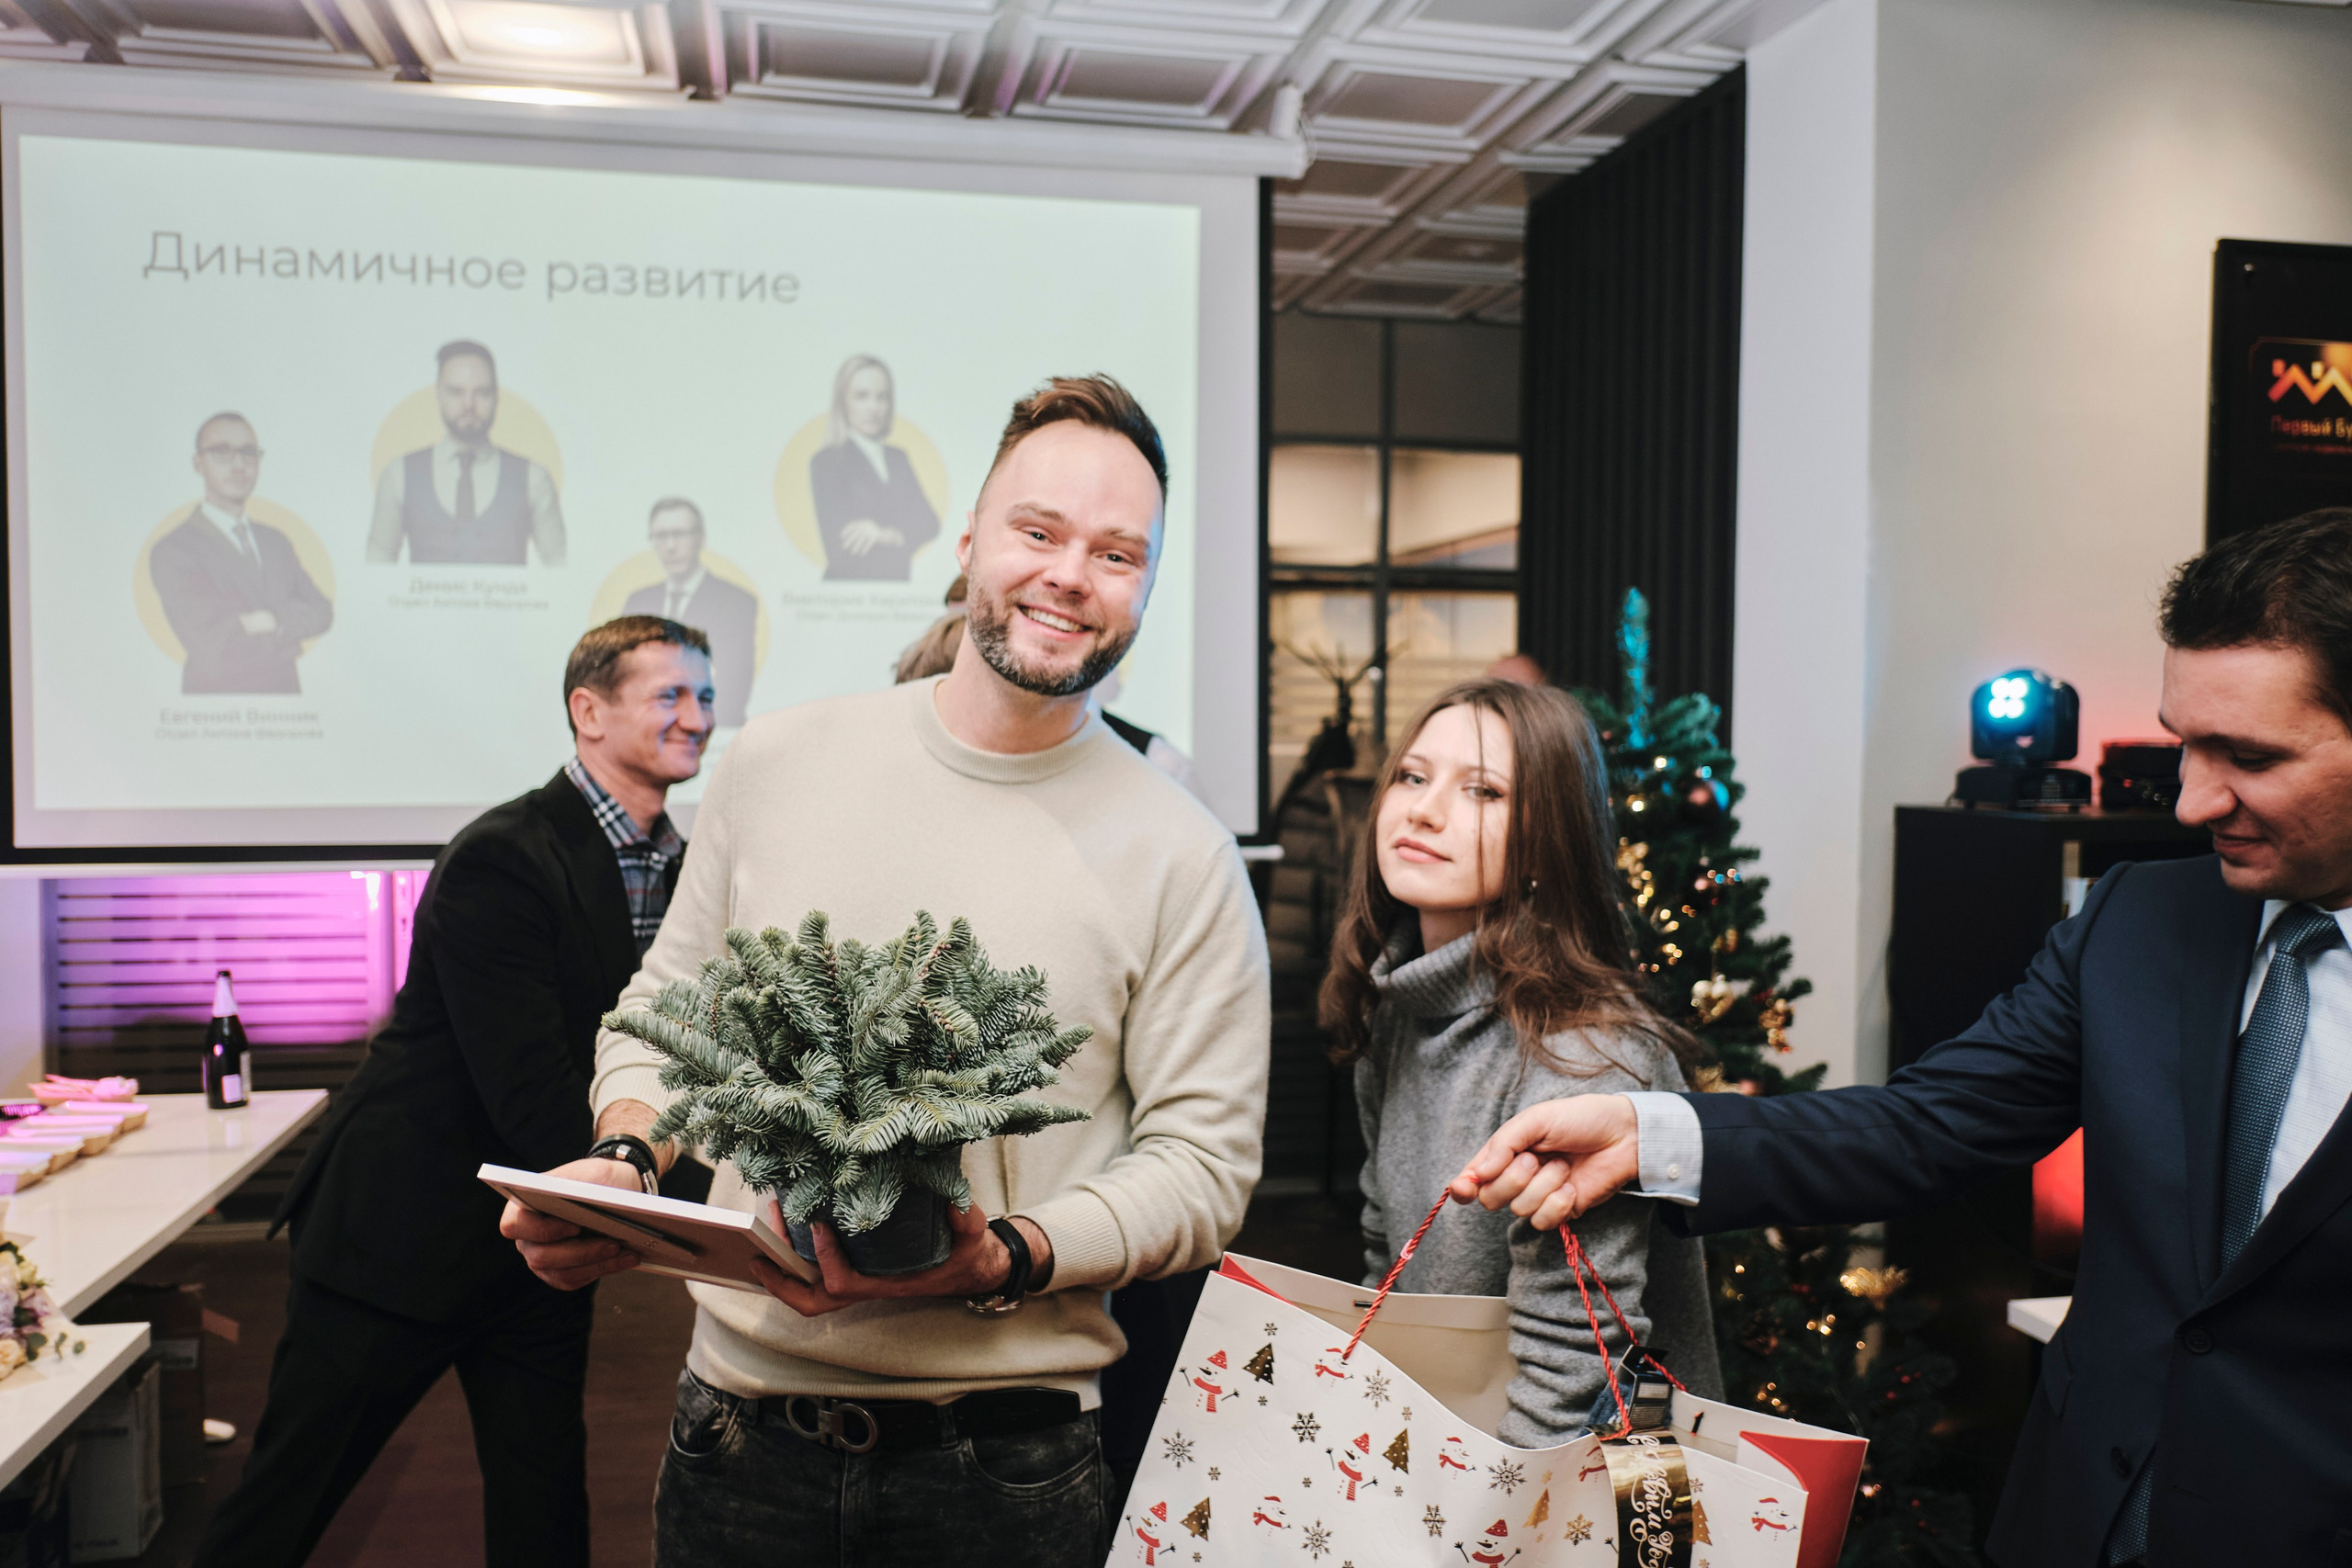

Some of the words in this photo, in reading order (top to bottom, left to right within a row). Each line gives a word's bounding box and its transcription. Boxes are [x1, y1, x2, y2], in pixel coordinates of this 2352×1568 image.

[143, 230, 528, 290] Динамичное
[548, 259, 802, 303] развитие
[2271, 414, 2332, 437] Первый
